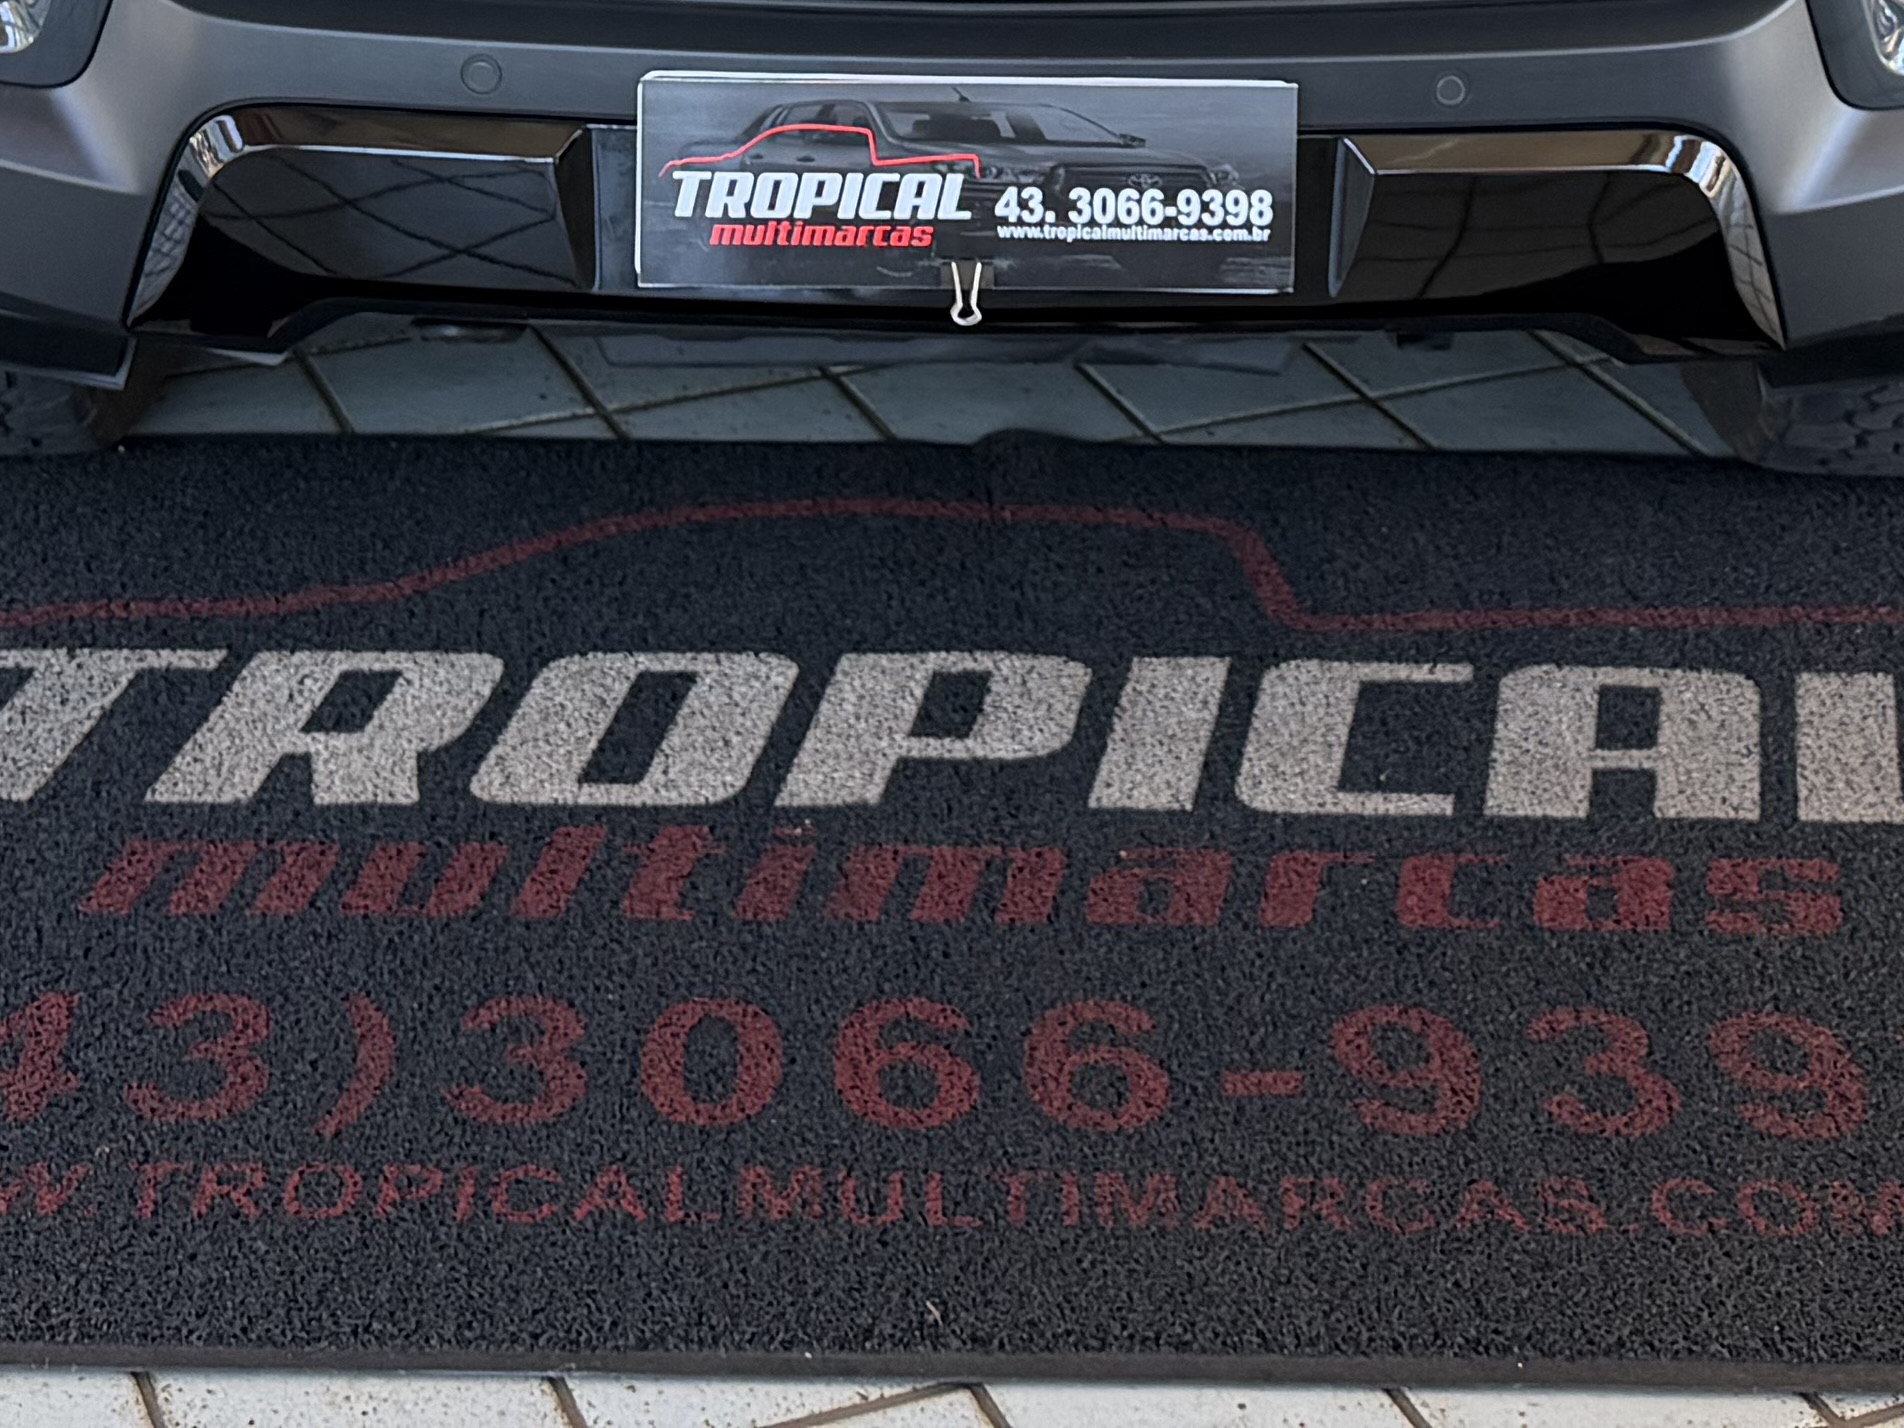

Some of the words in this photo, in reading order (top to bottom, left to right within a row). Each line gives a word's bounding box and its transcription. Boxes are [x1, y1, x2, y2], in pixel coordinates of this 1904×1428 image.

[672, 170, 973, 221] TROPICAL
[994, 186, 1056, 224] 43.
[1067, 186, 1274, 227] 3066-9398
[709, 220, 935, 248] multimarcas
[996, 222, 1272, 243] www.tropicalmultimarcas.com.br
[78, 824, 1843, 938] multimarcas
